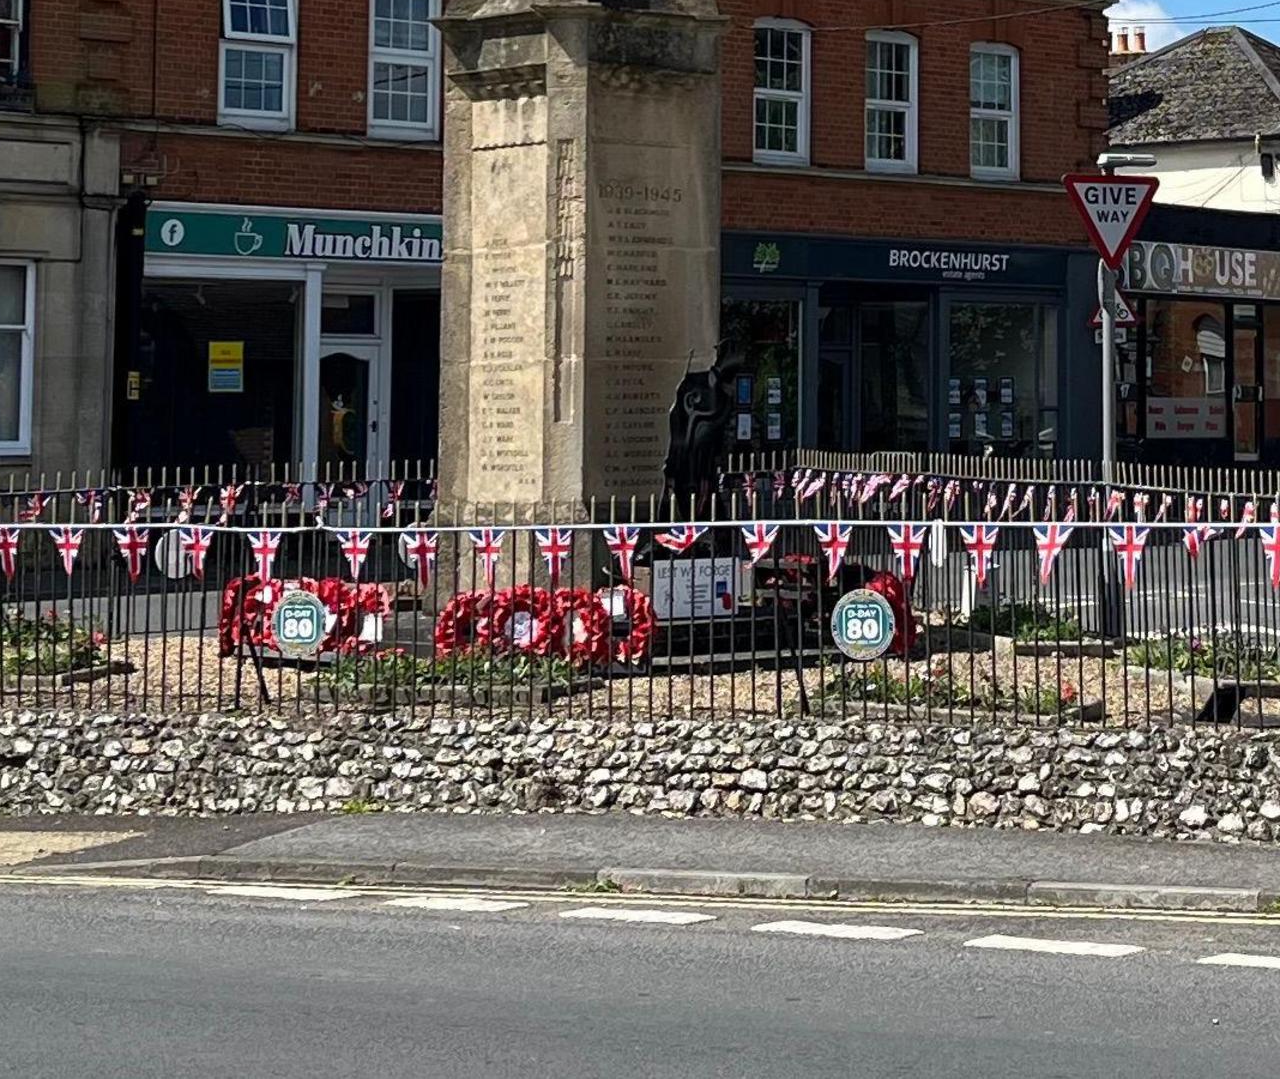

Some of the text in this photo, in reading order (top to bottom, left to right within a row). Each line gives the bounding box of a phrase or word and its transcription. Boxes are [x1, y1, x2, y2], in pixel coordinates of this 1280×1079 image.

[598, 183, 682, 202] 1939-1945
[1084, 186, 1137, 205] GIVE
[1096, 210, 1129, 223] WAY
[888, 249, 1010, 272] BROCKENHURST
[1117, 242, 1178, 289] BQ
[699, 564, 733, 577] FOGE
[847, 609, 877, 618] D-DAY
[283, 618, 313, 638] 80
[846, 618, 878, 640] 80
